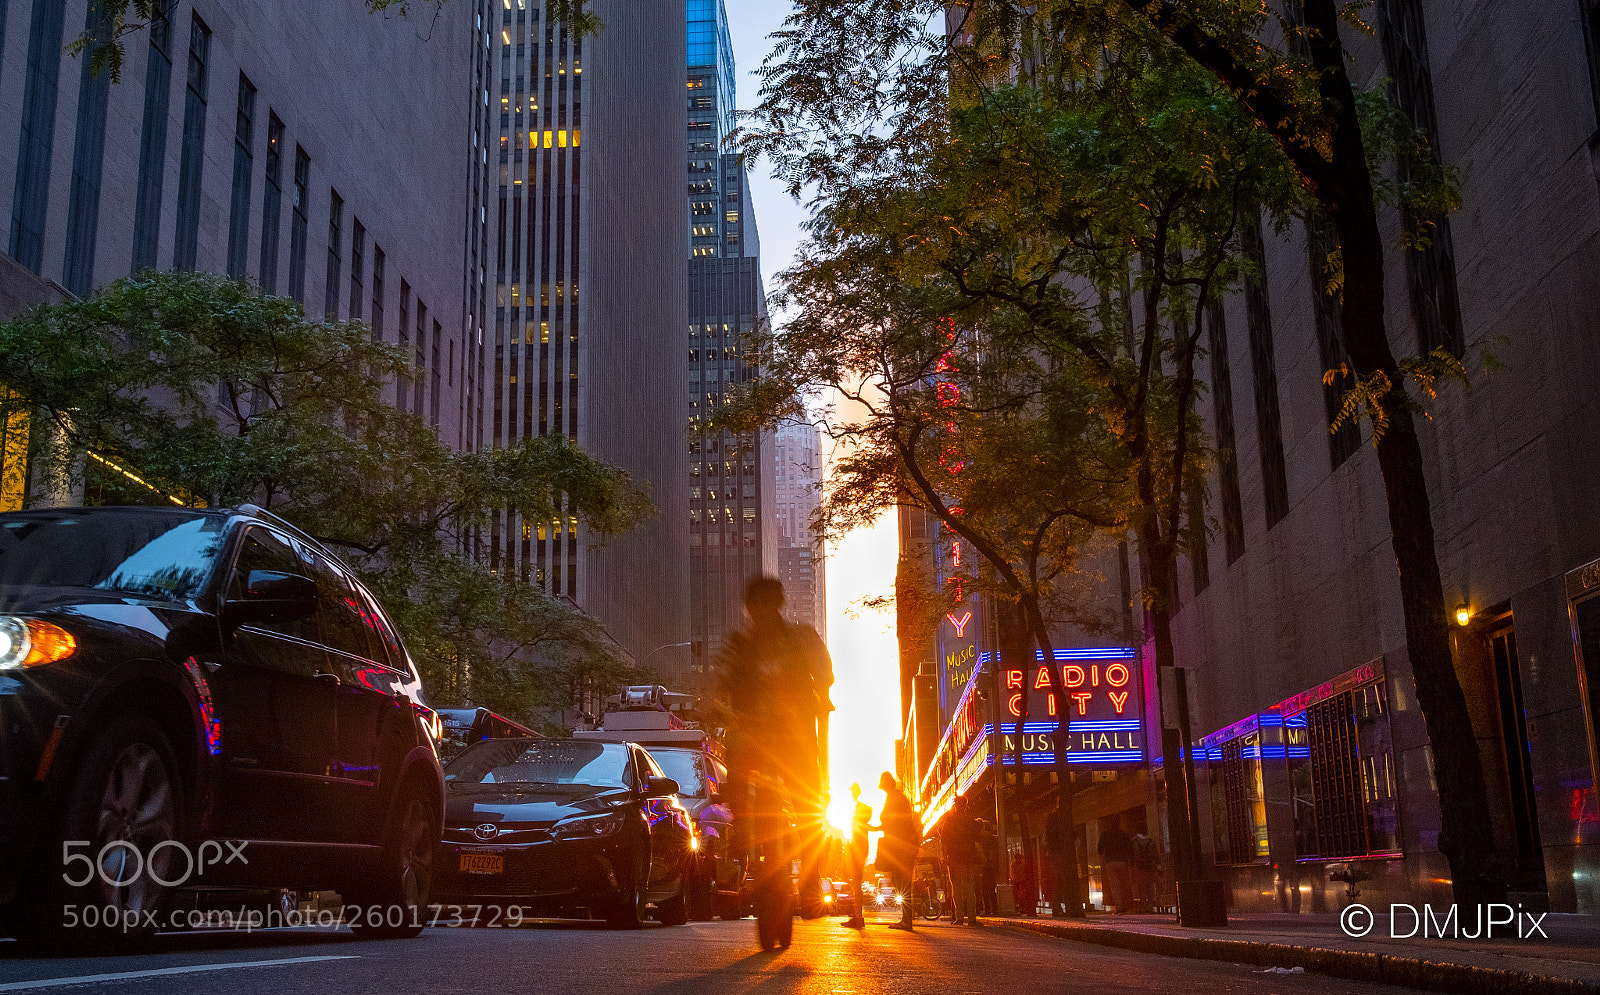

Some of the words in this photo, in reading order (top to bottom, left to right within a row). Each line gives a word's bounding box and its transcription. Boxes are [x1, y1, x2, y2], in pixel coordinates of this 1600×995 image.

[946, 645, 975, 671] MUSIC
[1006, 663, 1129, 689] RADIO
[1008, 691, 1129, 717] CITY
[1004, 733, 1072, 751] MUSI
[1081, 732, 1140, 750] HALL
